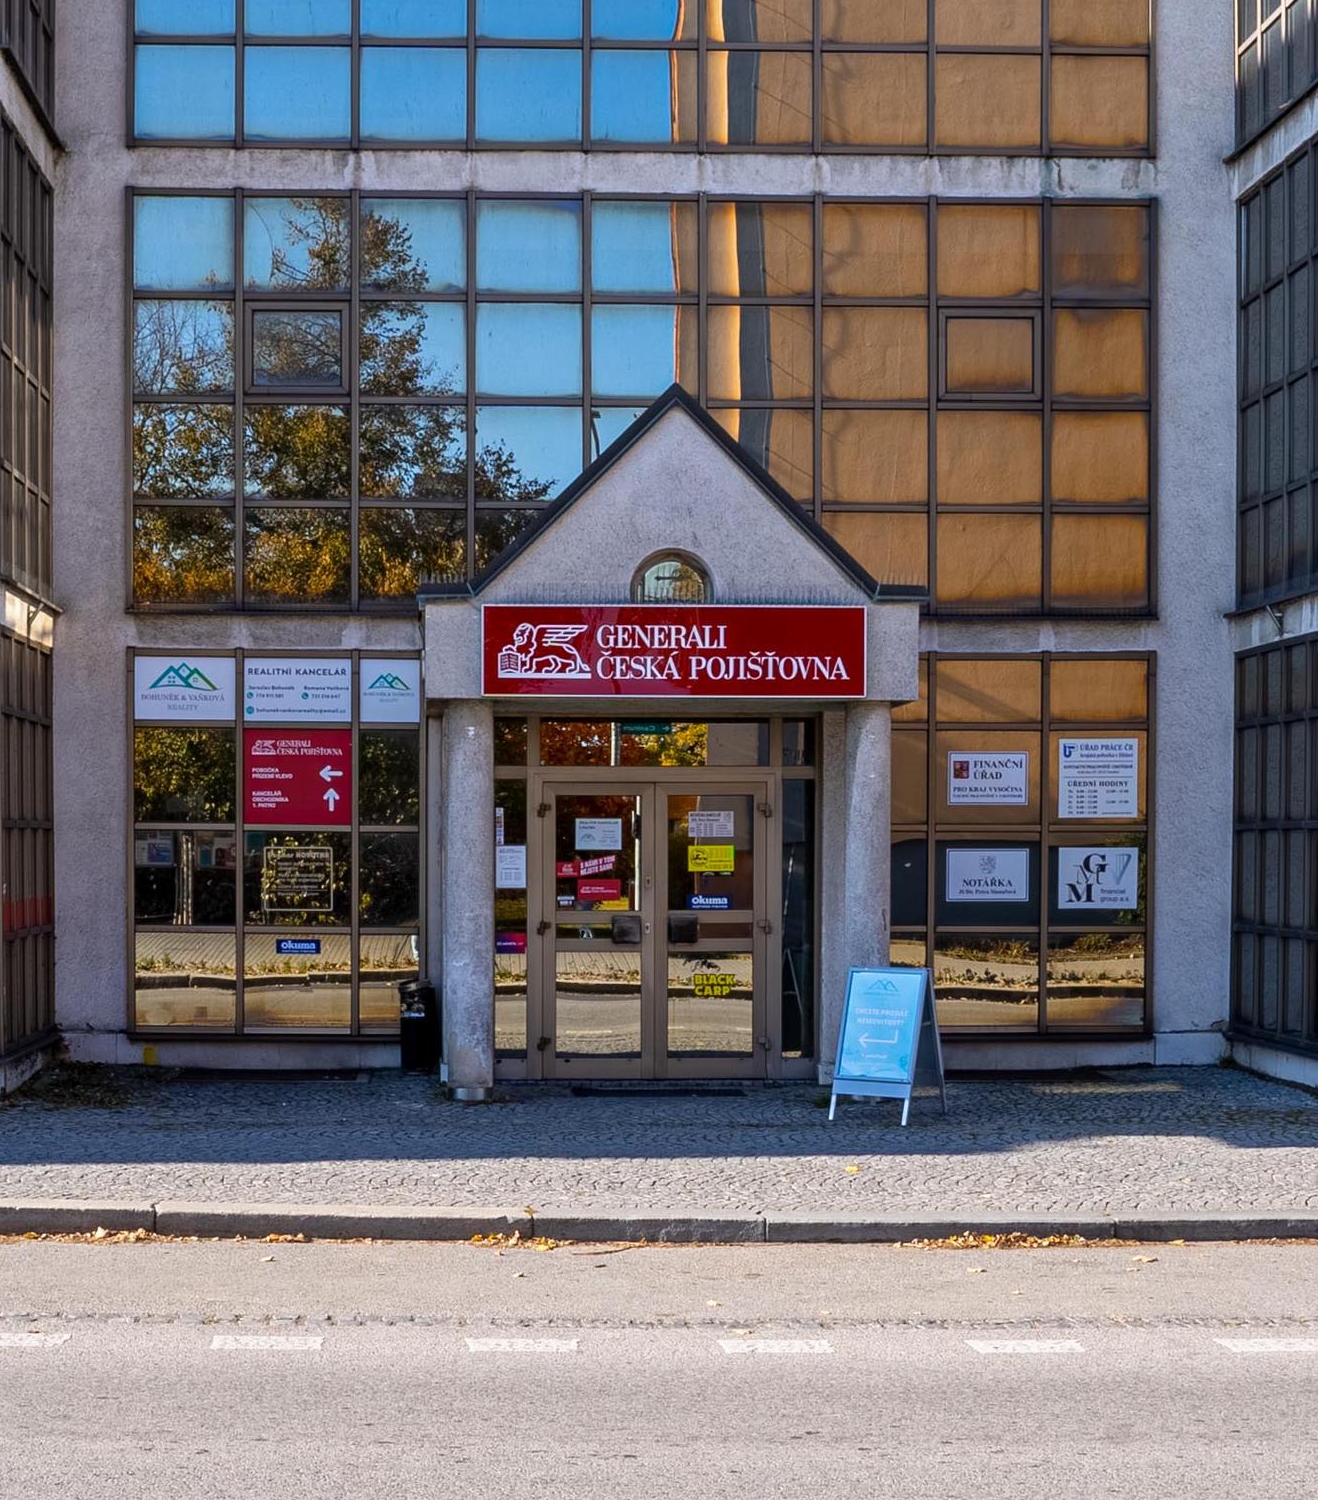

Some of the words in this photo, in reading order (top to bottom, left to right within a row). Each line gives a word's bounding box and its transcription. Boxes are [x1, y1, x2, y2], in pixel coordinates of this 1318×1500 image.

[595, 624, 727, 649] GENERALI
[595, 651, 680, 680] ČESKÁ
[688, 651, 850, 680] POJIŠŤOVNA
[247, 667, 292, 676] REALITNÍ
[295, 667, 347, 676] KANCELÁŘ
[276, 739, 311, 748] GENERALI
[276, 747, 299, 756] ČESKÁ
[973, 758, 1023, 769] FINANČNÍ
[973, 769, 1003, 780] ÚŘAD
[962, 877, 1013, 887] NOTÁŘKA
[691, 895, 728, 905] okuma
[280, 940, 316, 949] okuma
[694, 974, 735, 985] BLACK
[694, 986, 731, 996] CARP
